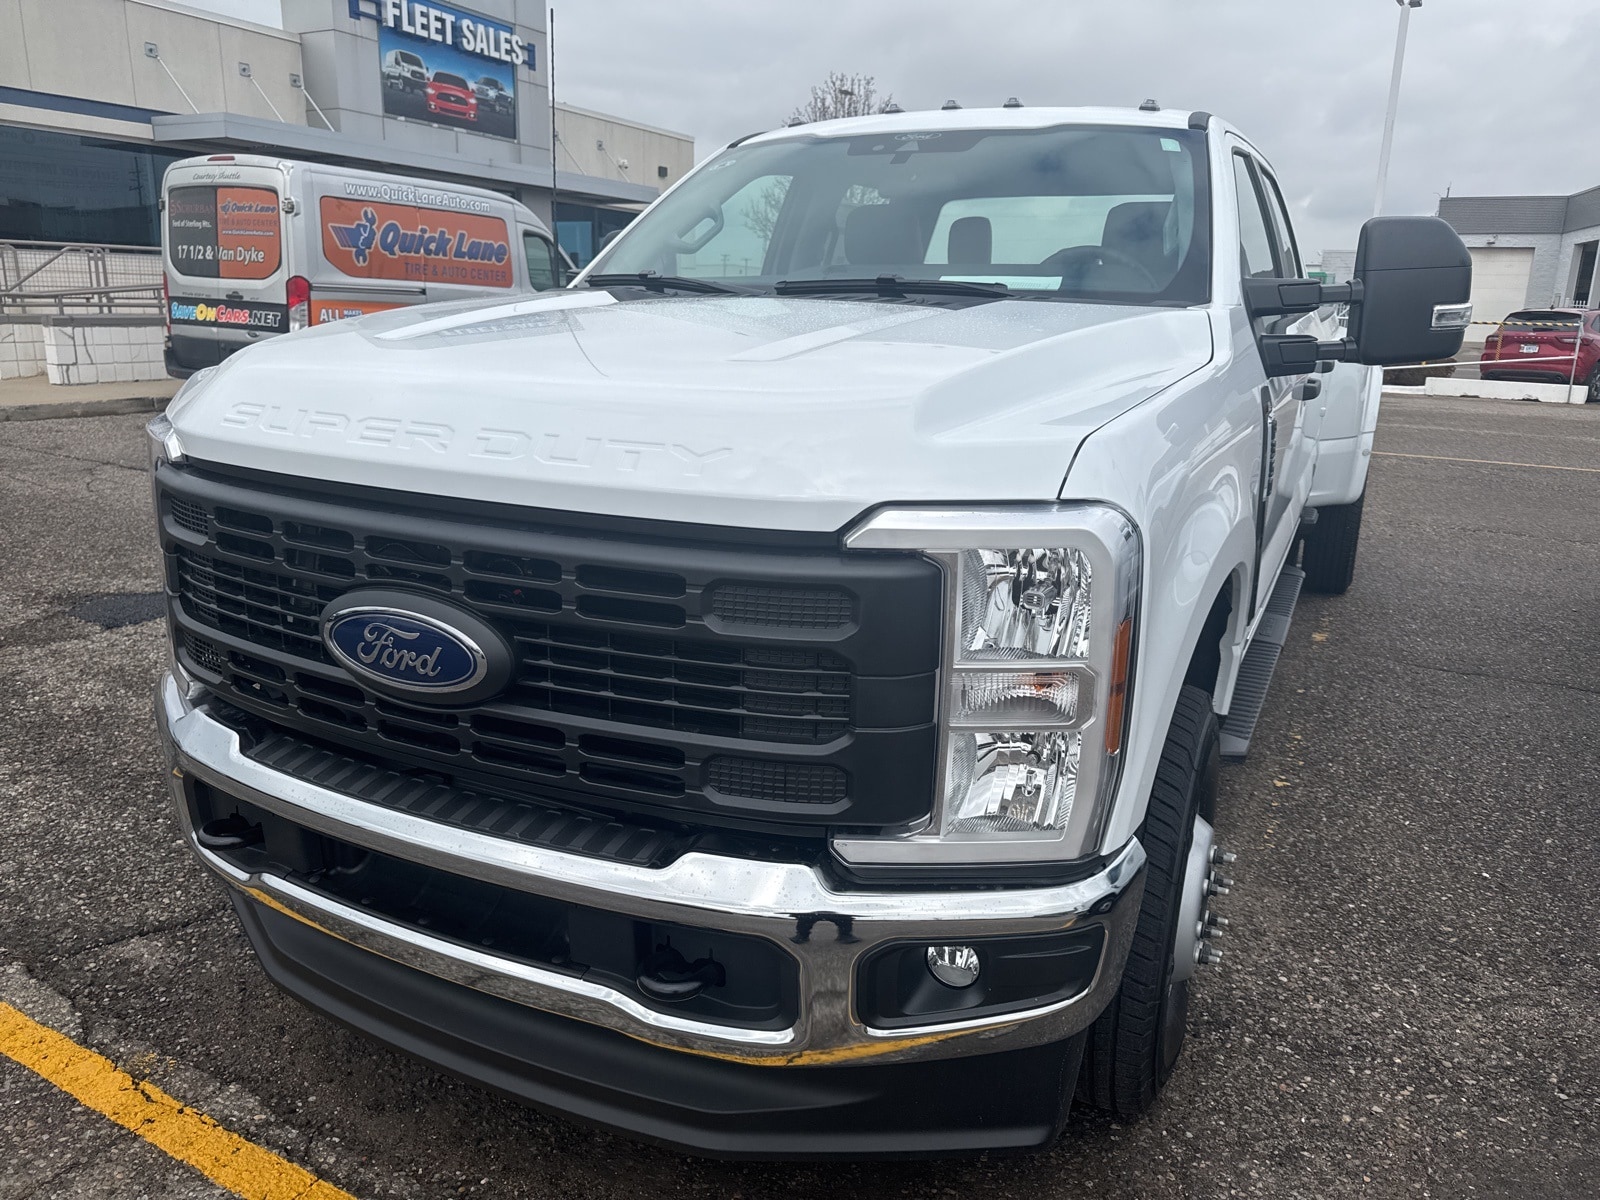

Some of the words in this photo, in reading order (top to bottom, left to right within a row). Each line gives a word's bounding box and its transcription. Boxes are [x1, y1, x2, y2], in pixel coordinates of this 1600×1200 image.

[385, 0, 456, 45] FLEET
[461, 18, 524, 65] SALES
[231, 202, 253, 214] Quick
[253, 203, 277, 214] Lane
[345, 183, 491, 212] www.QuickLaneAuto.com
[186, 219, 202, 230] Sterling
[177, 245, 188, 259] 17
[189, 245, 204, 260] 1/2
[205, 245, 214, 260] &
[215, 245, 234, 261] Van
[236, 246, 265, 265] Dyke
[379, 220, 452, 258] Quick
[453, 232, 509, 266] Lane
[404, 262, 430, 276] TIRE
[431, 264, 438, 276] &
[441, 264, 467, 279] AUTO
[471, 267, 508, 283] CENTER
[220, 401, 455, 454] SUPER
[468, 428, 734, 477] DUTY
[357, 622, 443, 677] Ford
